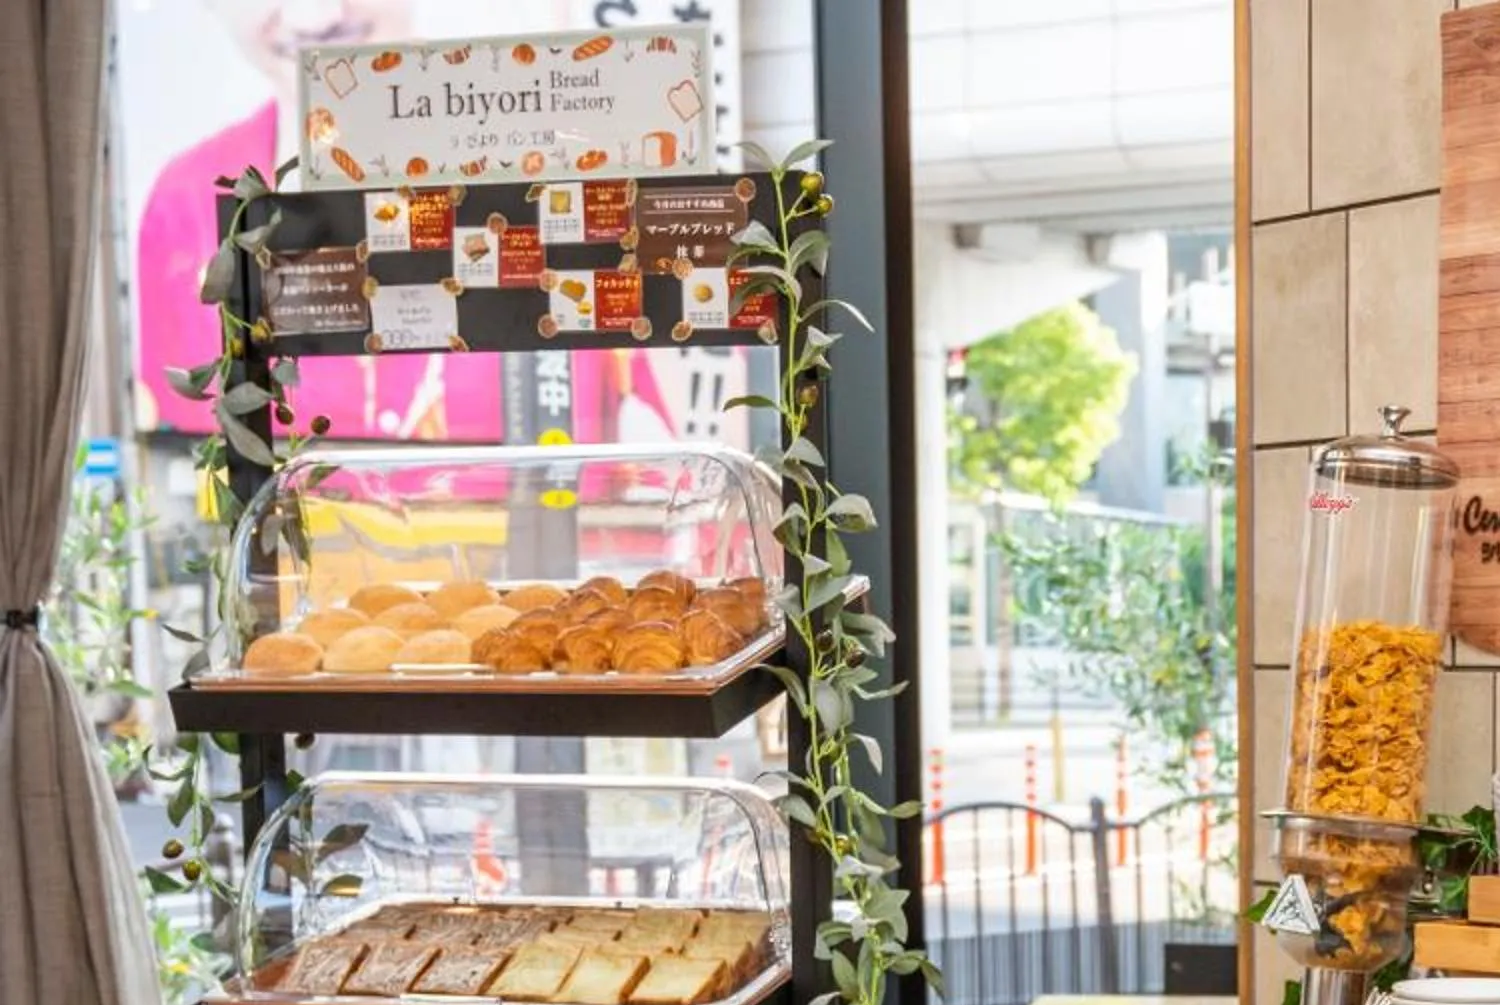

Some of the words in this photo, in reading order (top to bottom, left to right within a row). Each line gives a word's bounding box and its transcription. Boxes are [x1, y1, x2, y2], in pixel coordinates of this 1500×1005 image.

[550, 68, 600, 89] Bread
[389, 85, 432, 119] La
[443, 79, 543, 125] biyori
[551, 94, 615, 114] Factory
